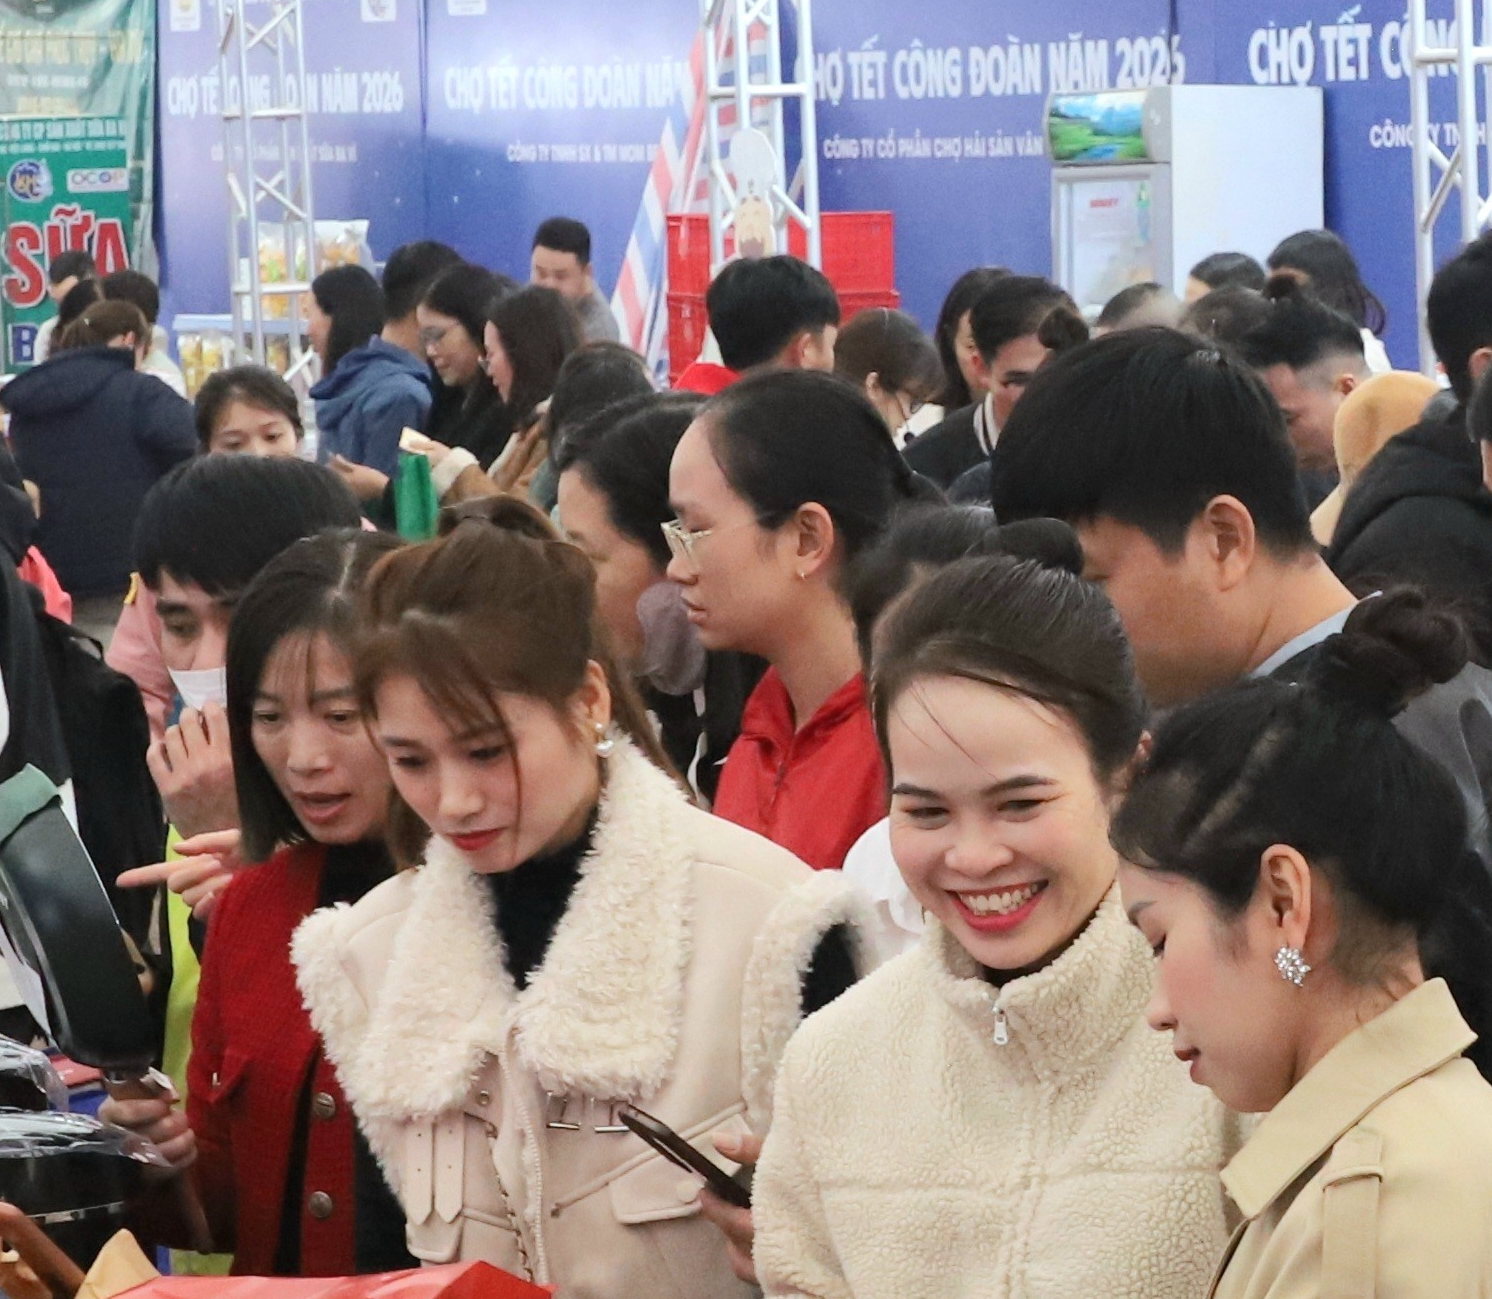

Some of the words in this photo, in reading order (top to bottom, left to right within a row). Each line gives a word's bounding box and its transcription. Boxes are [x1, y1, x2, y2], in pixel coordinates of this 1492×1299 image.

[847, 33, 888, 100] TẾT
[892, 37, 964, 100] CÔNG
[968, 32, 1043, 97] ĐOÀN
[1047, 30, 1110, 92] NĂM
[1247, 20, 1316, 88] CHỢ
[1319, 4, 1373, 82] TẾT
[321, 66, 358, 114] NĂM
[361, 70, 404, 114] 2026
[445, 59, 485, 115] CHỢ
[487, 52, 520, 110] TẾT
[522, 55, 579, 110] CÔNG
[583, 55, 642, 109] ĐOÀN
